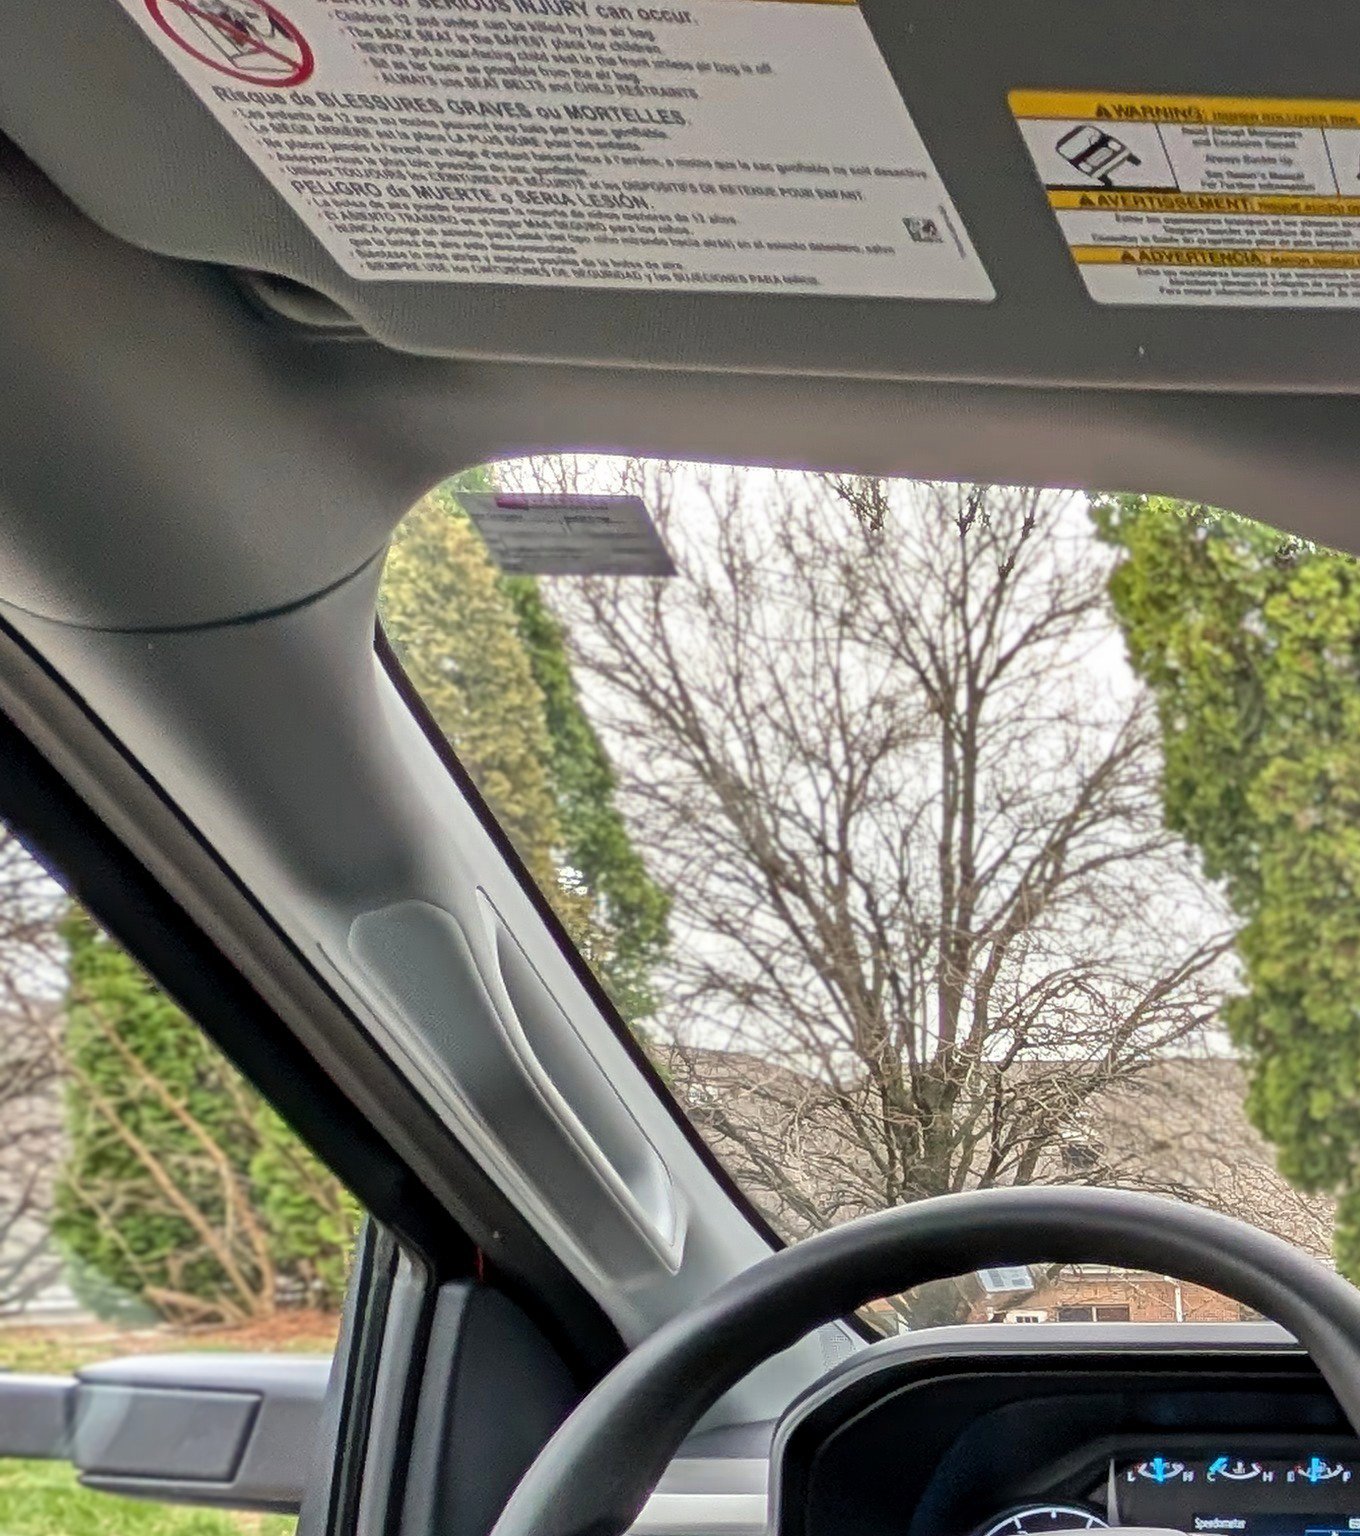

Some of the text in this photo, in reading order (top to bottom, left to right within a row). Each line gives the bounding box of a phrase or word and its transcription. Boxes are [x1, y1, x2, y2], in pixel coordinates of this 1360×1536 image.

[513, 0, 589, 16] INJURY
[596, 4, 633, 20] can
[212, 86, 288, 108] Risque
[290, 91, 316, 107] de
[316, 92, 444, 115] BLESSURES
[446, 99, 532, 118] GRAVES
[535, 107, 562, 121] ou
[291, 180, 382, 198] PELIGRO
[385, 183, 410, 198] de
[411, 184, 496, 204] MUERTE
[515, 189, 577, 207] SERIA
[1194, 1517, 1247, 1531] Speedometer
